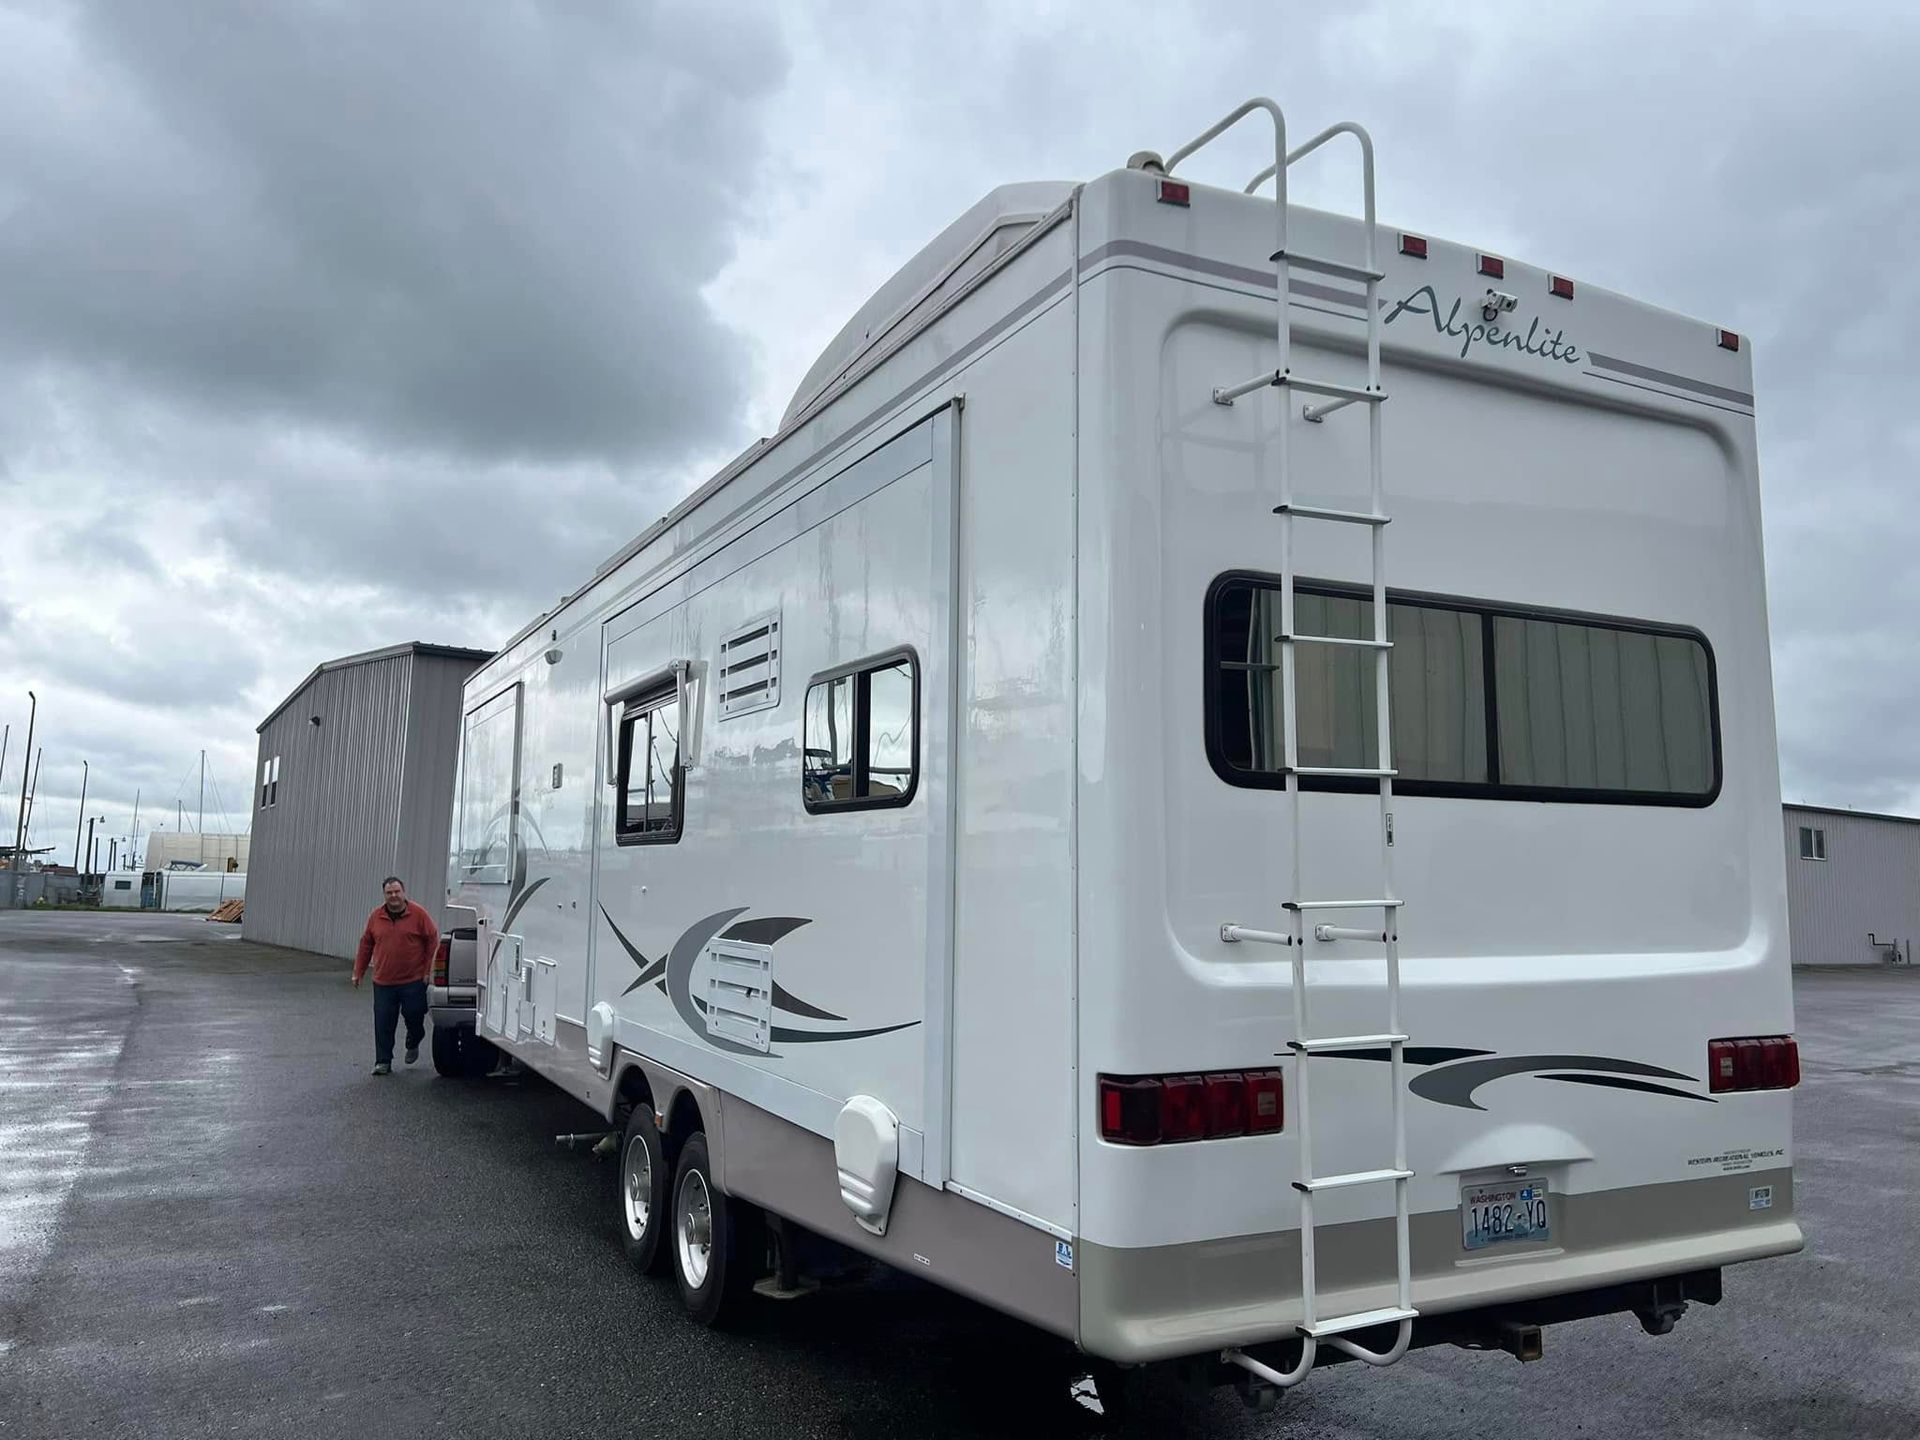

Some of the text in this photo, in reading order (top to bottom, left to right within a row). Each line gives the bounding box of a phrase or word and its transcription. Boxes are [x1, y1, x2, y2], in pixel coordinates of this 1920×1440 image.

[1384, 285, 1580, 363] Alpenlite
[1471, 1192, 1516, 1204] WASHINGTON
[1472, 1205, 1513, 1237] 1482
